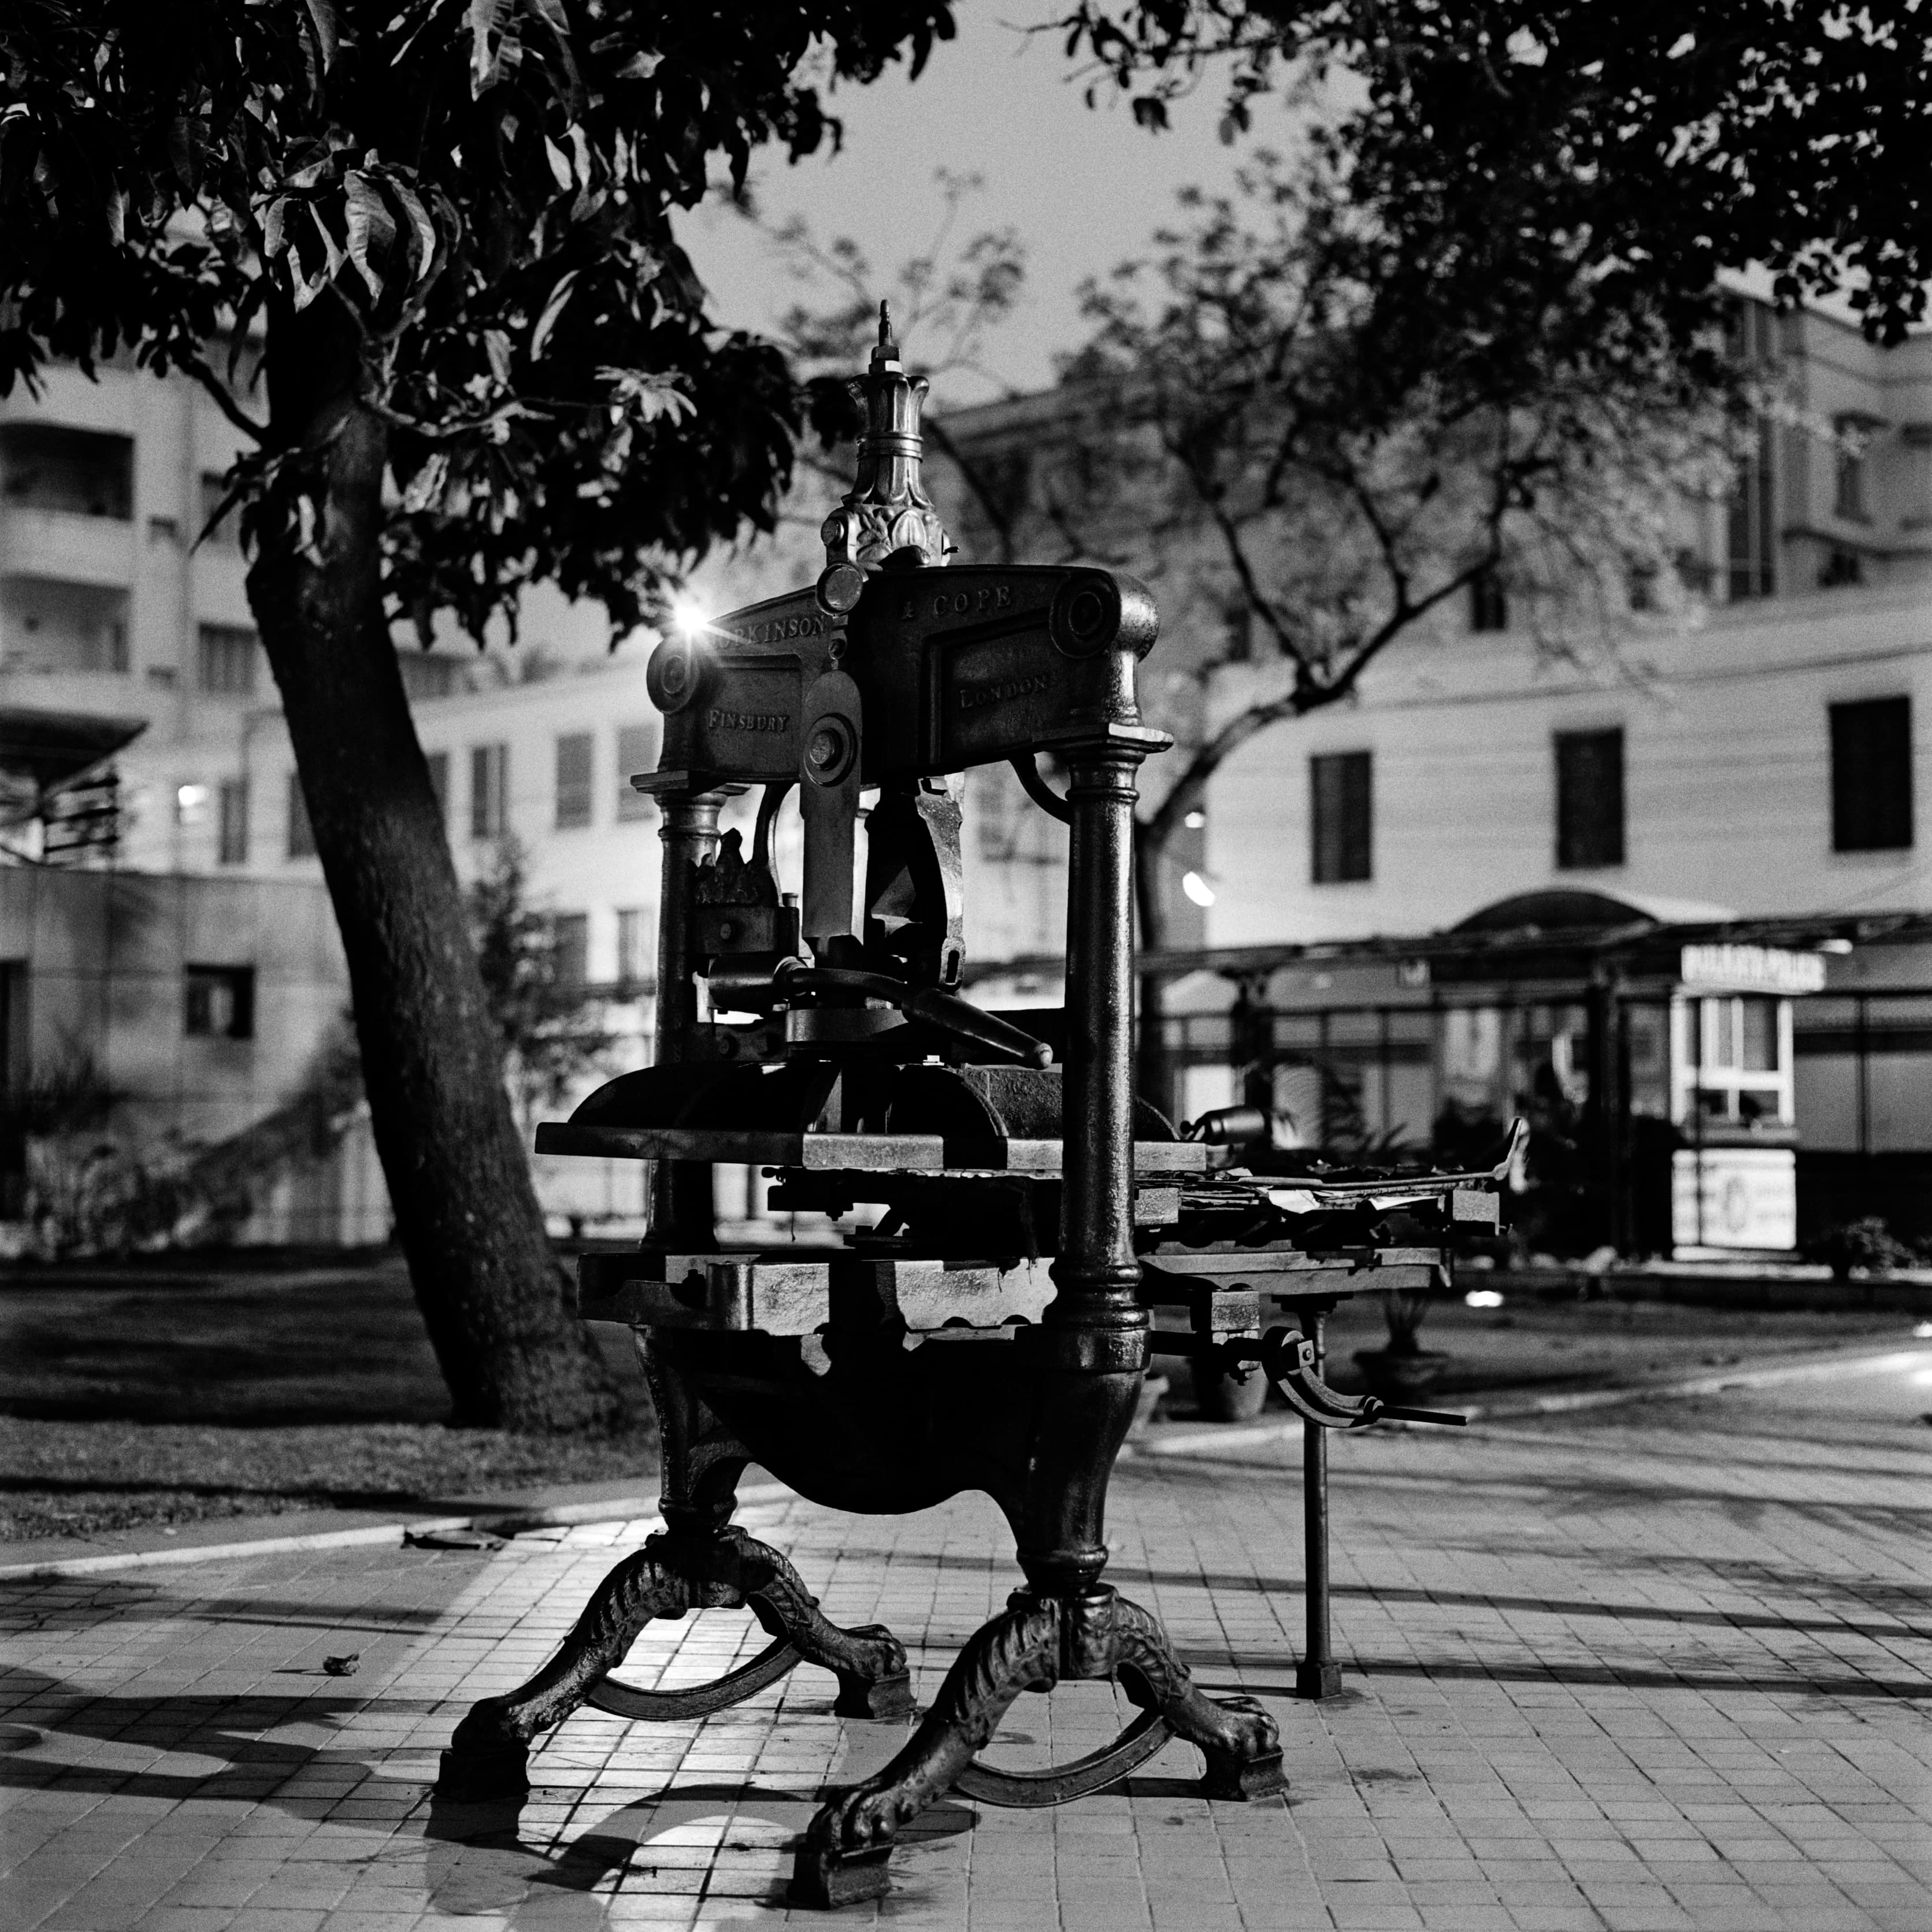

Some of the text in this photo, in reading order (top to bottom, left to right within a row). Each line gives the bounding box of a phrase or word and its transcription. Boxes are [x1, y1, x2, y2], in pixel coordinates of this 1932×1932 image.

[933, 585, 1012, 616] COPE
[958, 670, 1049, 709] LONDON
[708, 709, 790, 732] FINSBURY
